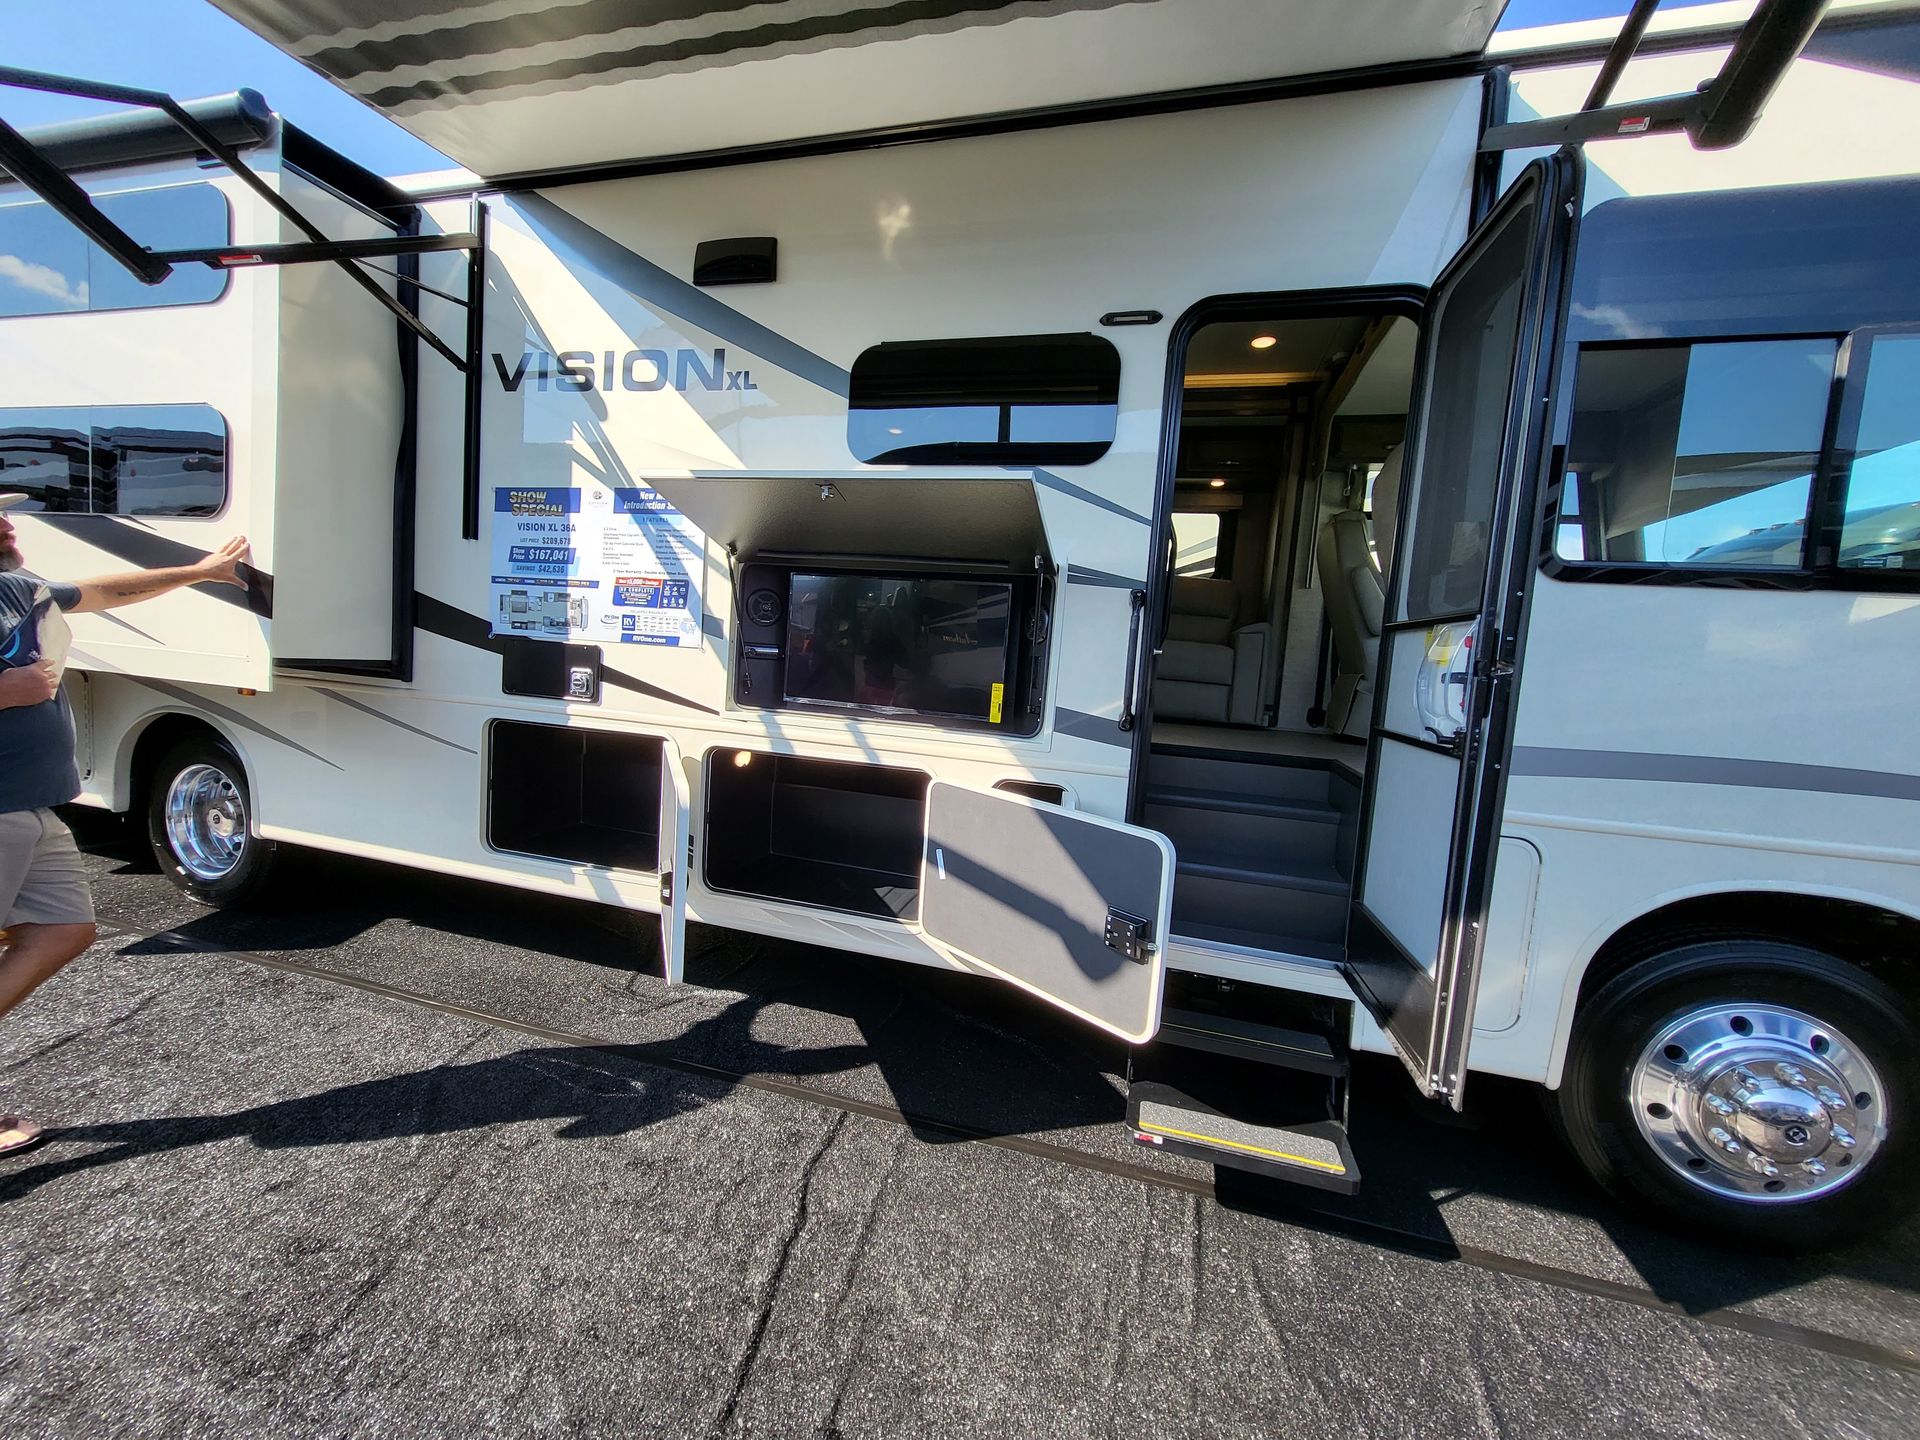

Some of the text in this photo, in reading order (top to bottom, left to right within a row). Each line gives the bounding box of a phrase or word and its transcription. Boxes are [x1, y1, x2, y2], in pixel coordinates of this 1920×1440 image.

[491, 348, 758, 393] VISION XL
[509, 491, 547, 503] SHOW
[639, 492, 655, 500] New
[512, 504, 565, 517] SPECIAL
[623, 501, 666, 510] Introduction
[517, 522, 576, 533] VISION XL 36A
[528, 549, 569, 562] $167,041
[624, 618, 634, 626] RV
